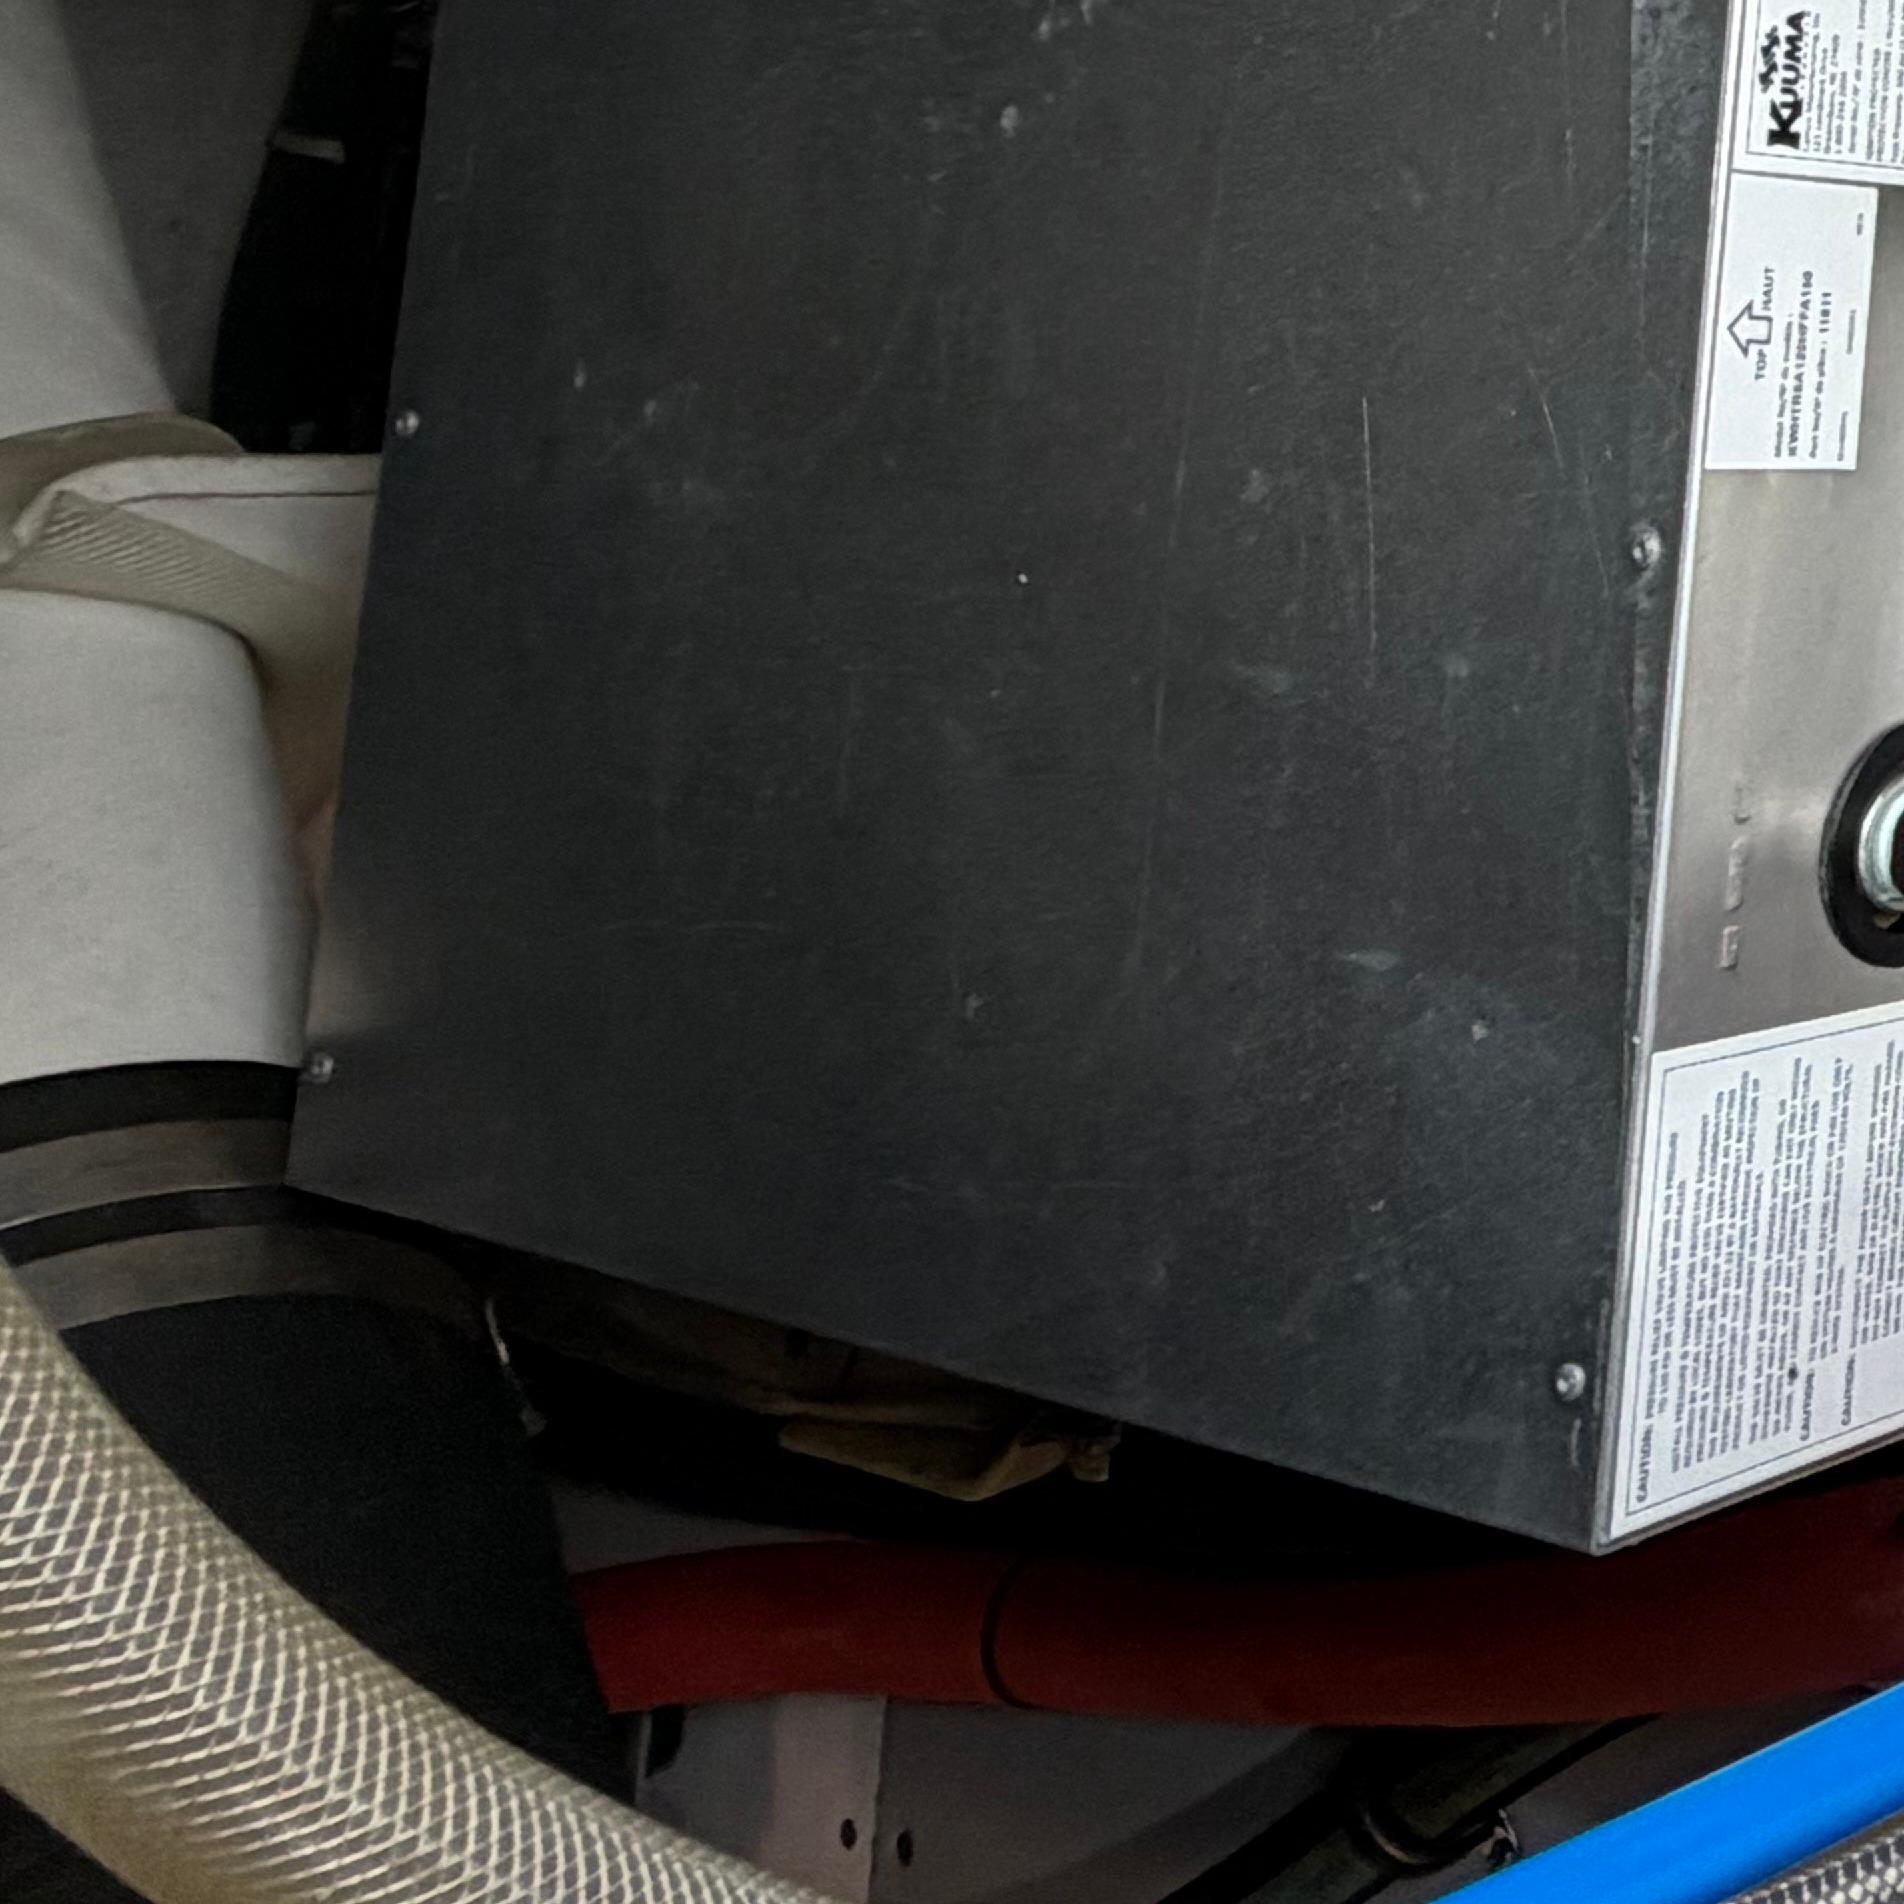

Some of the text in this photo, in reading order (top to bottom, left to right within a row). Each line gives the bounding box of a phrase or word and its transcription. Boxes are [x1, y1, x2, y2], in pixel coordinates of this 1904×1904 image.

[1767, 9, 1811, 149] KUUMA
[1760, 265, 1775, 311] HAUT
[1753, 348, 1767, 380] TOP
